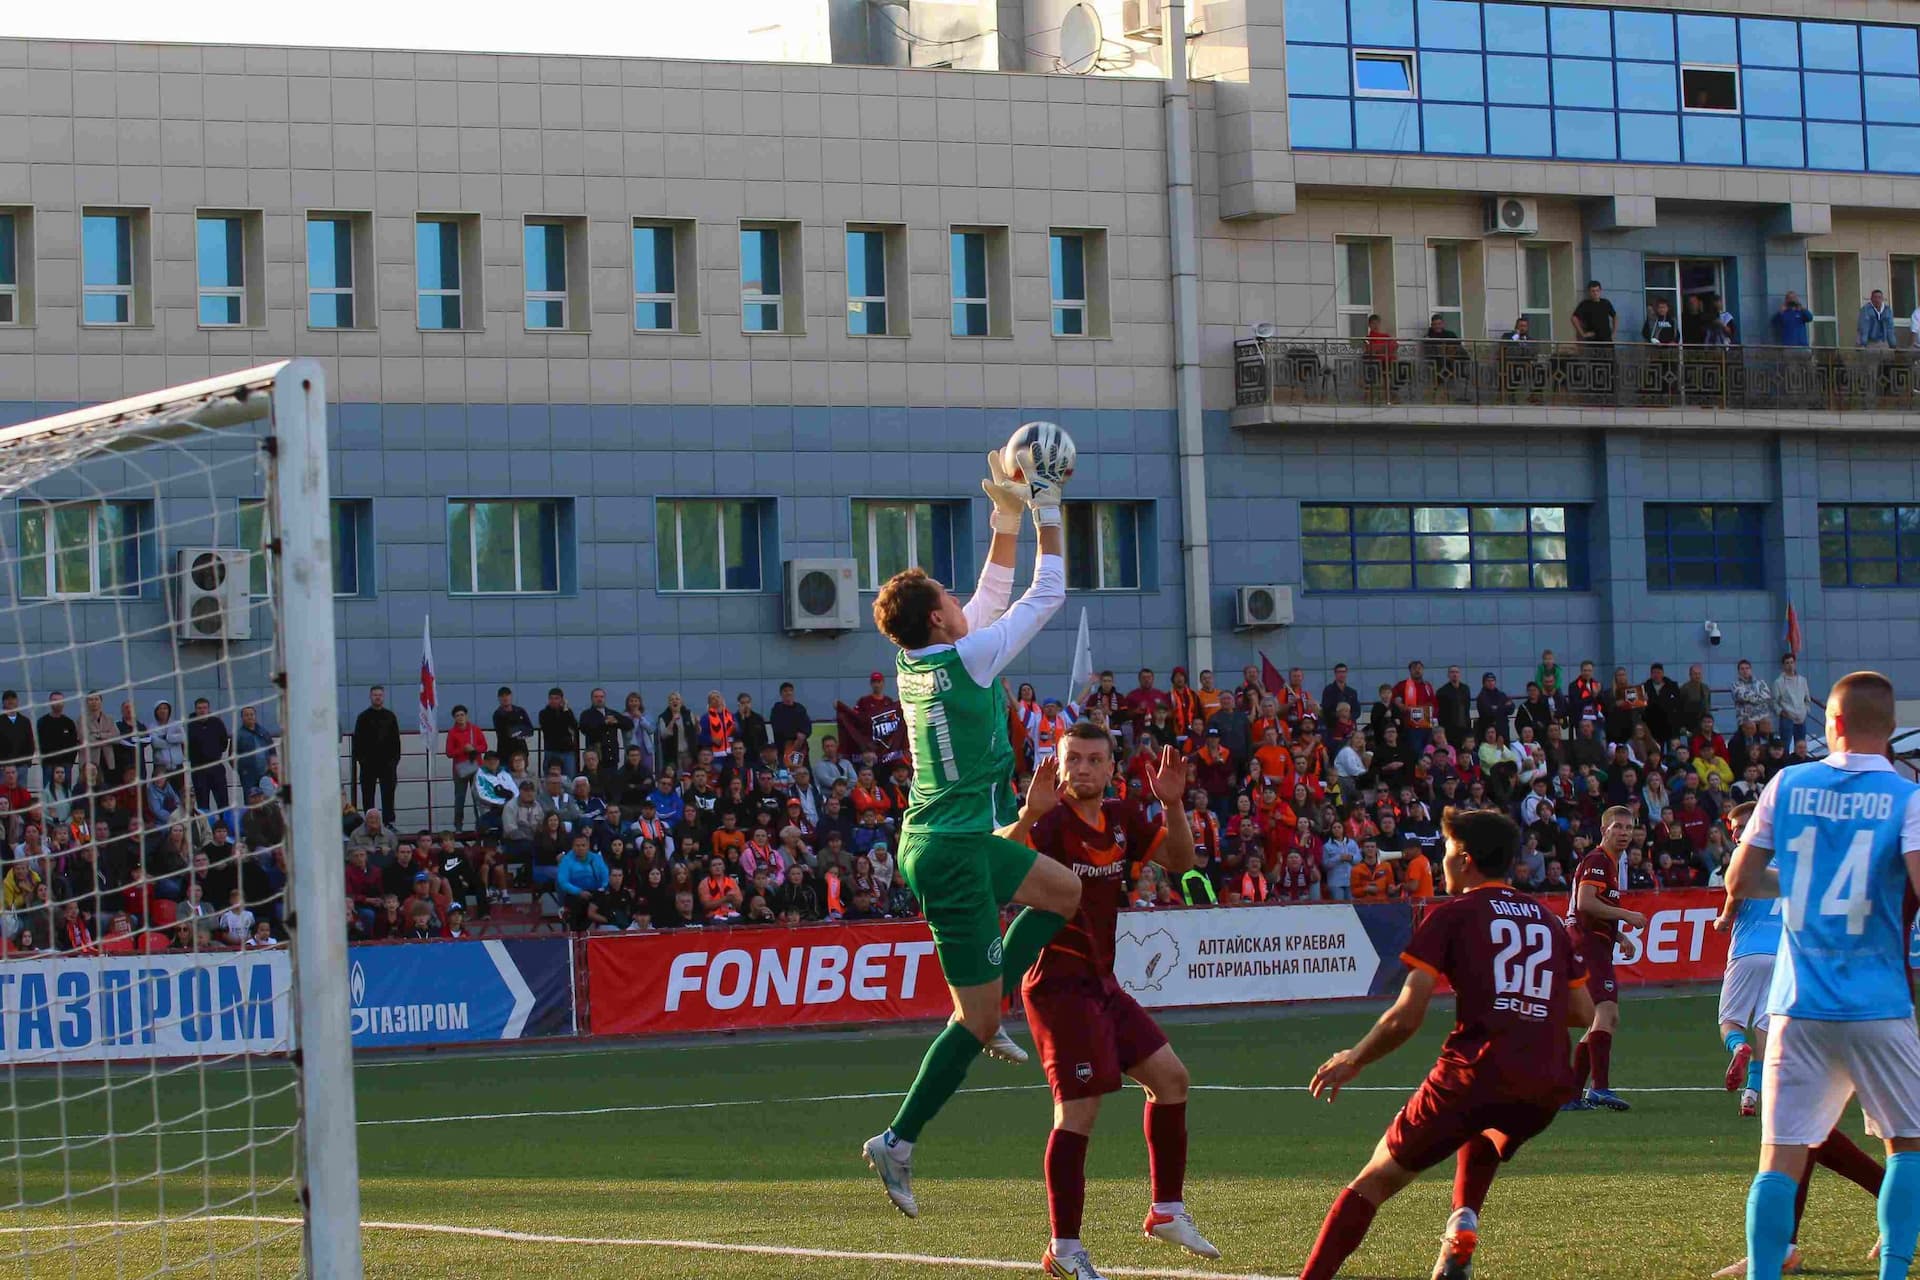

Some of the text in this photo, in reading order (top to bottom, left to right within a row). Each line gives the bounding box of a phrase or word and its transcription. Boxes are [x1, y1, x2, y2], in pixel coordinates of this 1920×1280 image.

[1789, 787, 1893, 822] ПЕЩЕРОВ
[1786, 826, 1876, 935] 14
[1489, 900, 1542, 920] БАБИЧ
[1198, 934, 1345, 955] АЛТАЙСКАЯ КРАЕВАЯ
[1489, 918, 1554, 1001] 22
[664, 940, 935, 1012] FONBET
[1188, 956, 1356, 979] НОТАРИАЛЬНАЯ ПАЛАТА
[370, 1002, 469, 1034] ГАЗПРОМ
